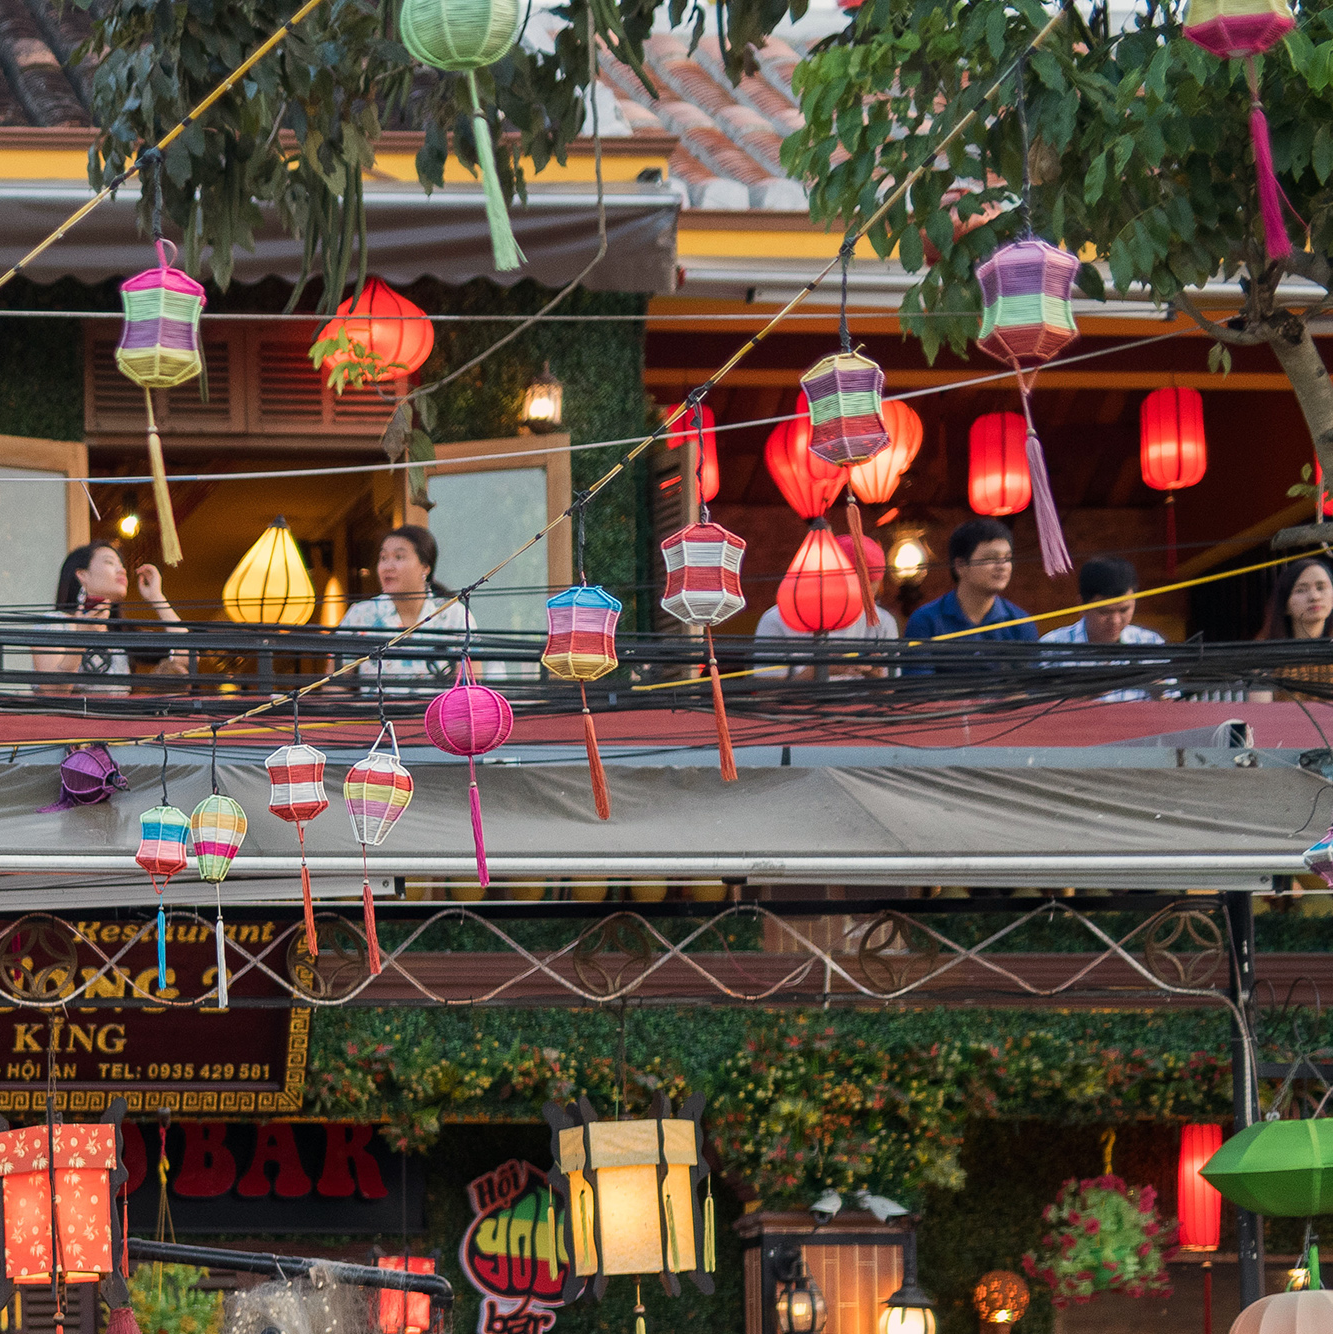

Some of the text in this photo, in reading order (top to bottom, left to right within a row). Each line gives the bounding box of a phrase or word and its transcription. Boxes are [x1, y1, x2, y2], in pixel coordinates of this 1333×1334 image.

[13, 1022, 127, 1053] KING
[7, 1060, 41, 1078] HỘI
[52, 1063, 77, 1078] AN
[98, 1063, 141, 1078] TEL:
[148, 1063, 194, 1078] 0935
[199, 1063, 233, 1078] 429
[239, 1063, 270, 1078] 581
[173, 1122, 389, 1198] BAR
